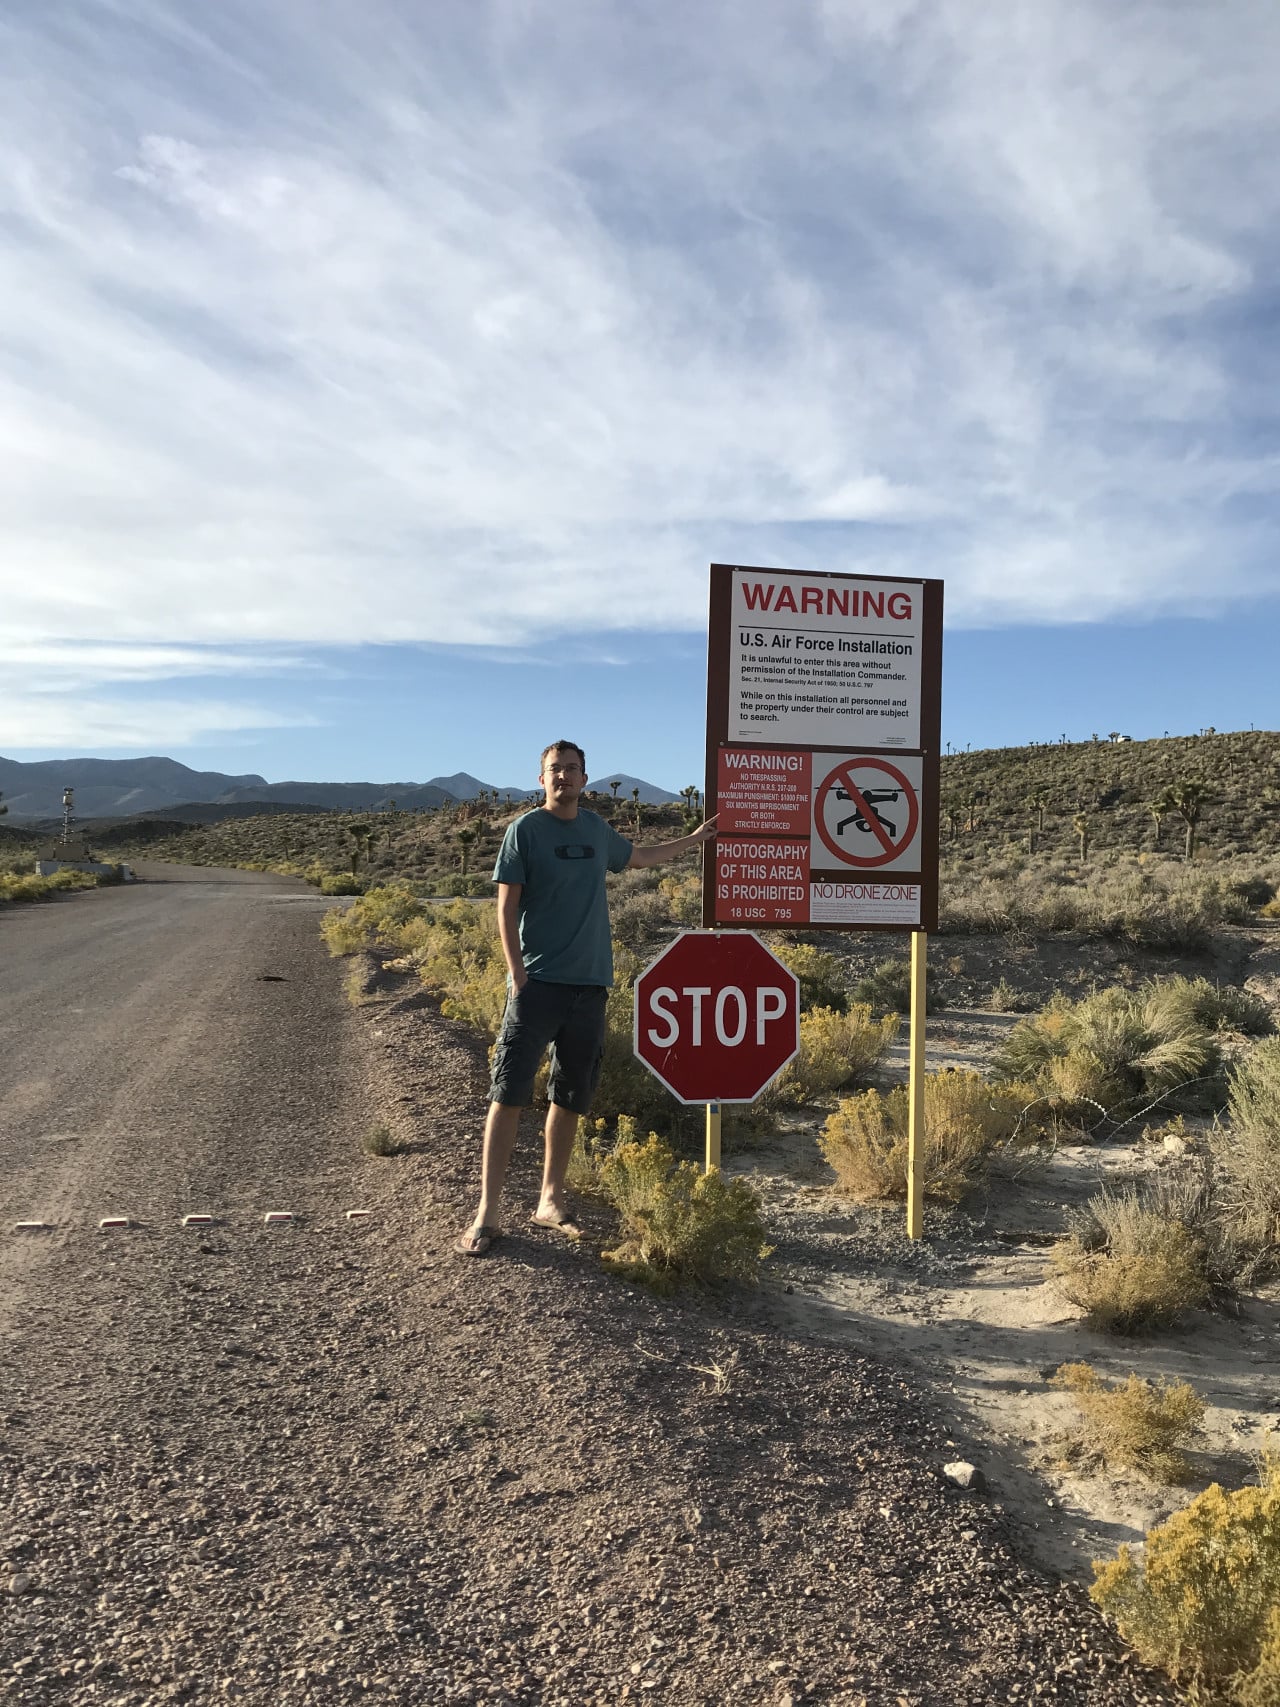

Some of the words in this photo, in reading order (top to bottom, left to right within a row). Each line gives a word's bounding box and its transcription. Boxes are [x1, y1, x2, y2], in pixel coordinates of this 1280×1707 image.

[742, 583, 912, 620] WARNING
[740, 633, 767, 647] U.S.
[772, 635, 792, 649] Air
[796, 636, 834, 651] Force
[839, 639, 912, 655] Installation
[862, 661, 891, 669] without
[812, 669, 855, 677] Installation
[858, 671, 907, 680] Commander.
[795, 694, 837, 703] installation
[755, 704, 788, 712] property
[880, 709, 908, 718] subject
[725, 754, 802, 771] WARNING!
[717, 843, 808, 859] PHOTOGRAPHY
[720, 864, 737, 878] OF
[740, 864, 766, 879] THIS
[769, 866, 802, 880] AREA
[718, 885, 728, 898] IS
[733, 885, 804, 901] PROHIBITED
[814, 884, 833, 898] NO
[836, 885, 880, 899] DRONE
[883, 886, 917, 900] ZONE
[731, 908, 742, 917] 18
[745, 908, 766, 918] USC
[775, 909, 791, 918] 795
[648, 986, 786, 1047] STOP
